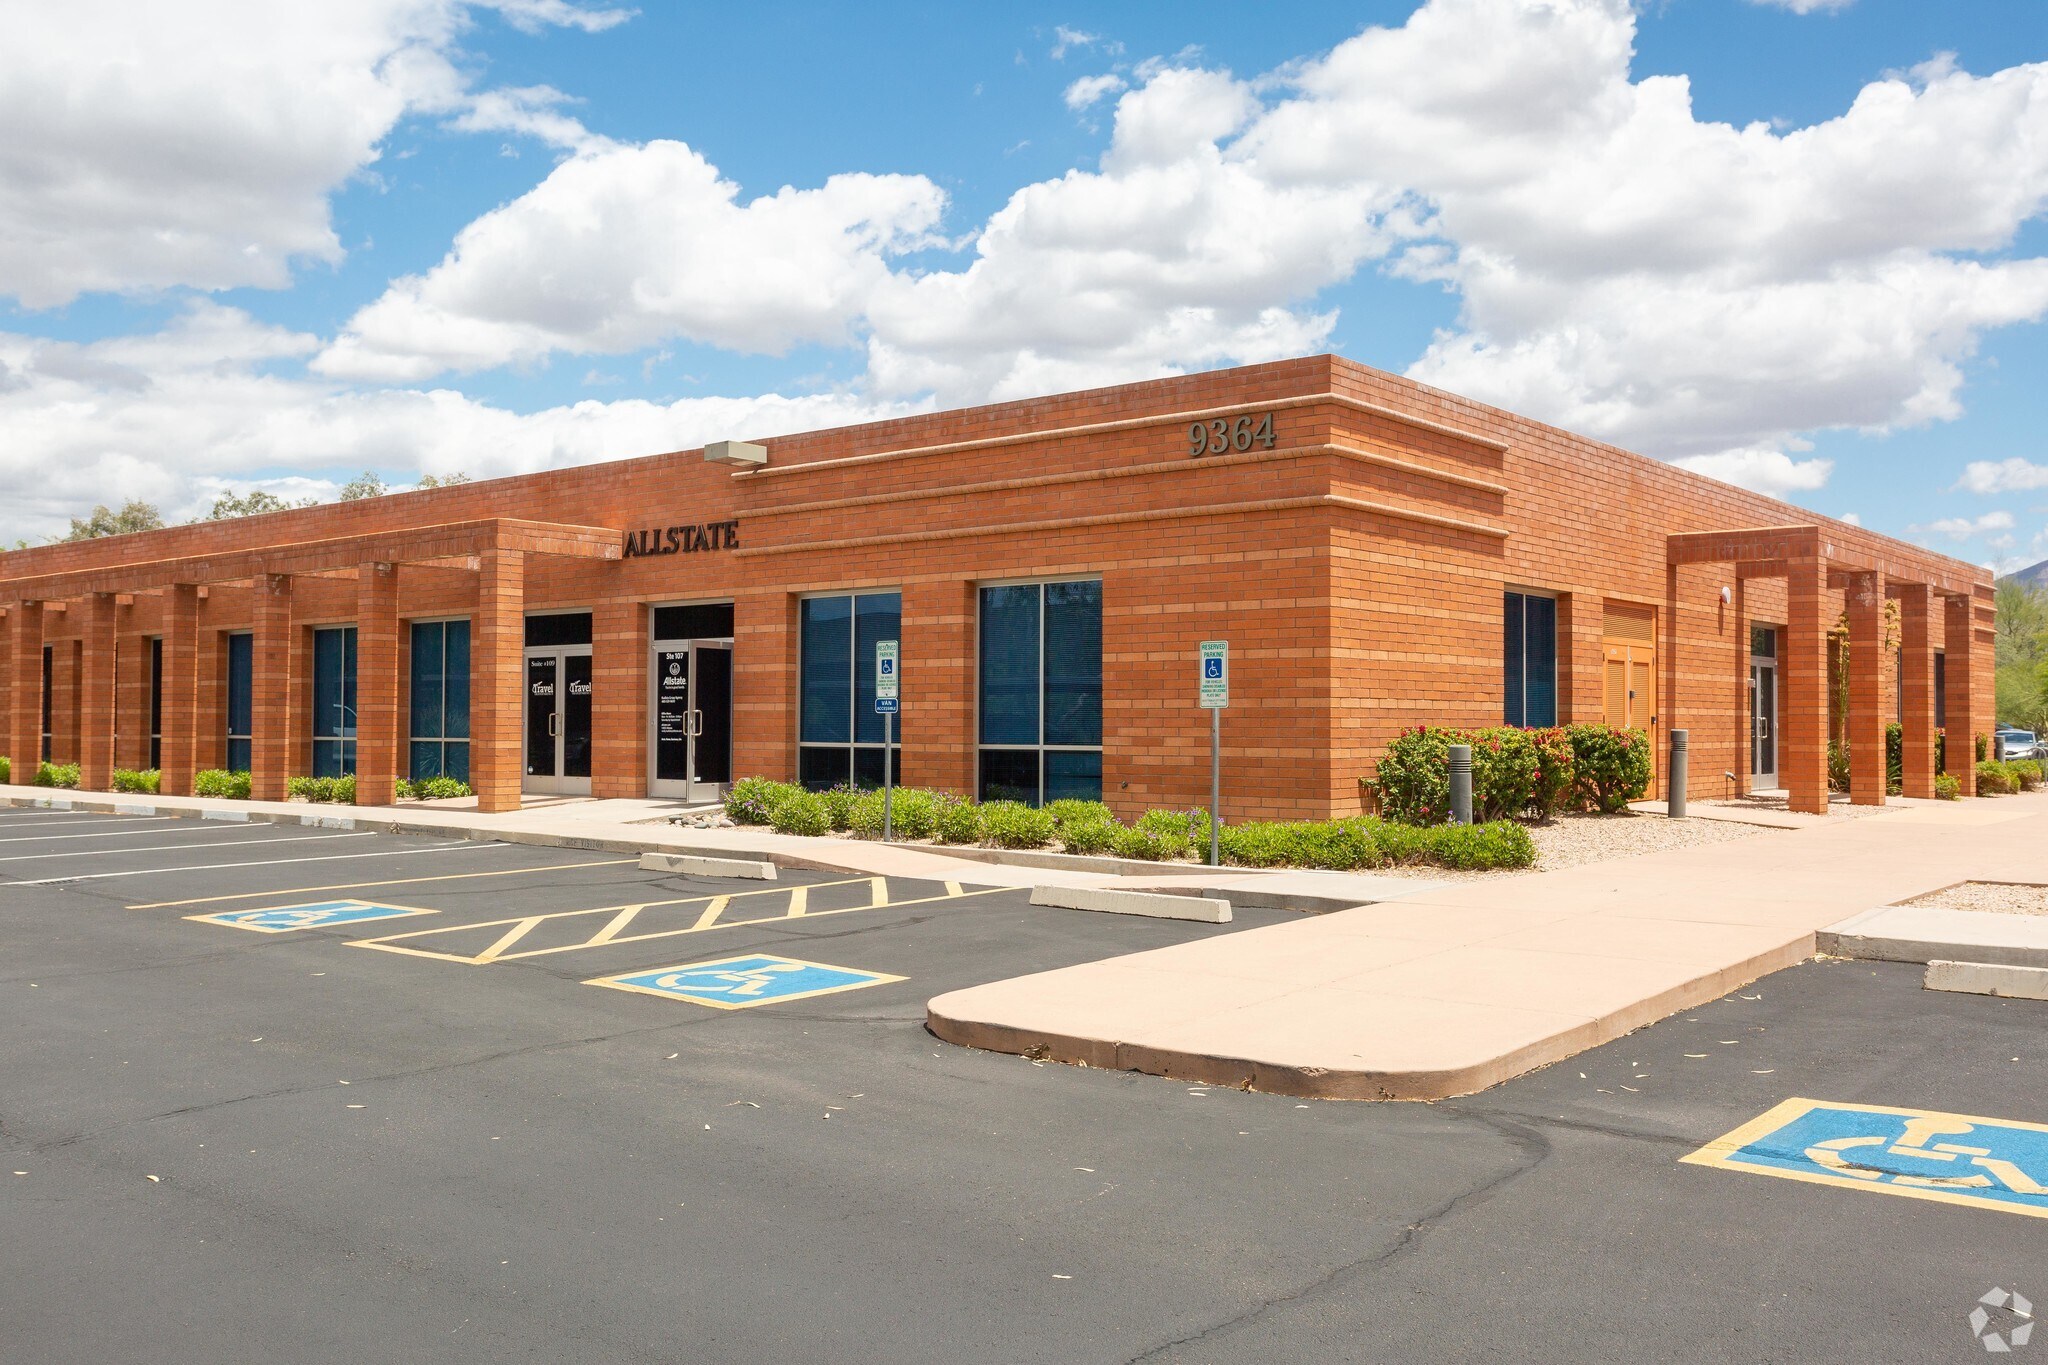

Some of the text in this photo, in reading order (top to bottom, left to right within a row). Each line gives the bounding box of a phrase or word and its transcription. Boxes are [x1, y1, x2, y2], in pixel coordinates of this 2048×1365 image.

[1187, 412, 1277, 457] 9364
[623, 520, 739, 558] ALLSTATE
[666, 652, 684, 660] Ste 107
[532, 681, 554, 693] Travel
[569, 680, 592, 693] Travel
[663, 676, 686, 686] Allstate
